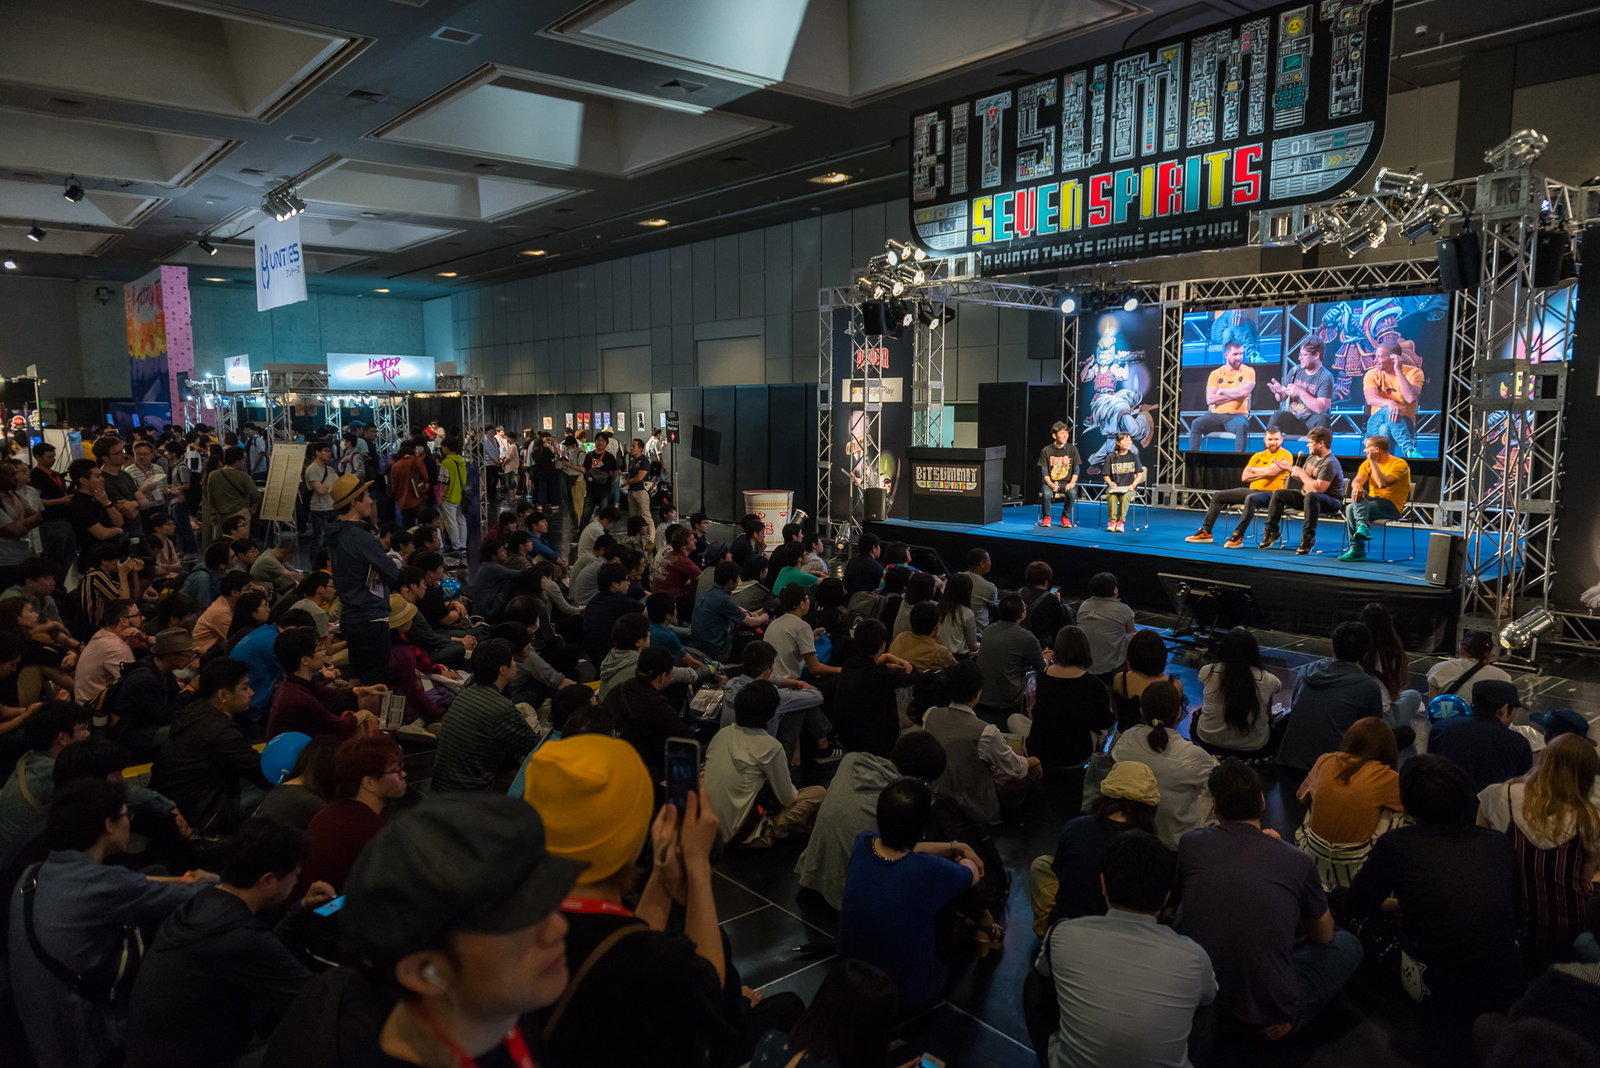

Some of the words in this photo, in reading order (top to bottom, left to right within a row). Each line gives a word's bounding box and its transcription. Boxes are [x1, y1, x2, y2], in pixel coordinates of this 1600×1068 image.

[913, 0, 1382, 202] BITSUMMIT
[972, 179, 1083, 246] SEVEN
[1088, 143, 1263, 228] SPIRITS
[1096, 233, 1145, 256] GAME
[1148, 220, 1244, 251] FESTIVAL
[381, 368, 401, 389] RUN
